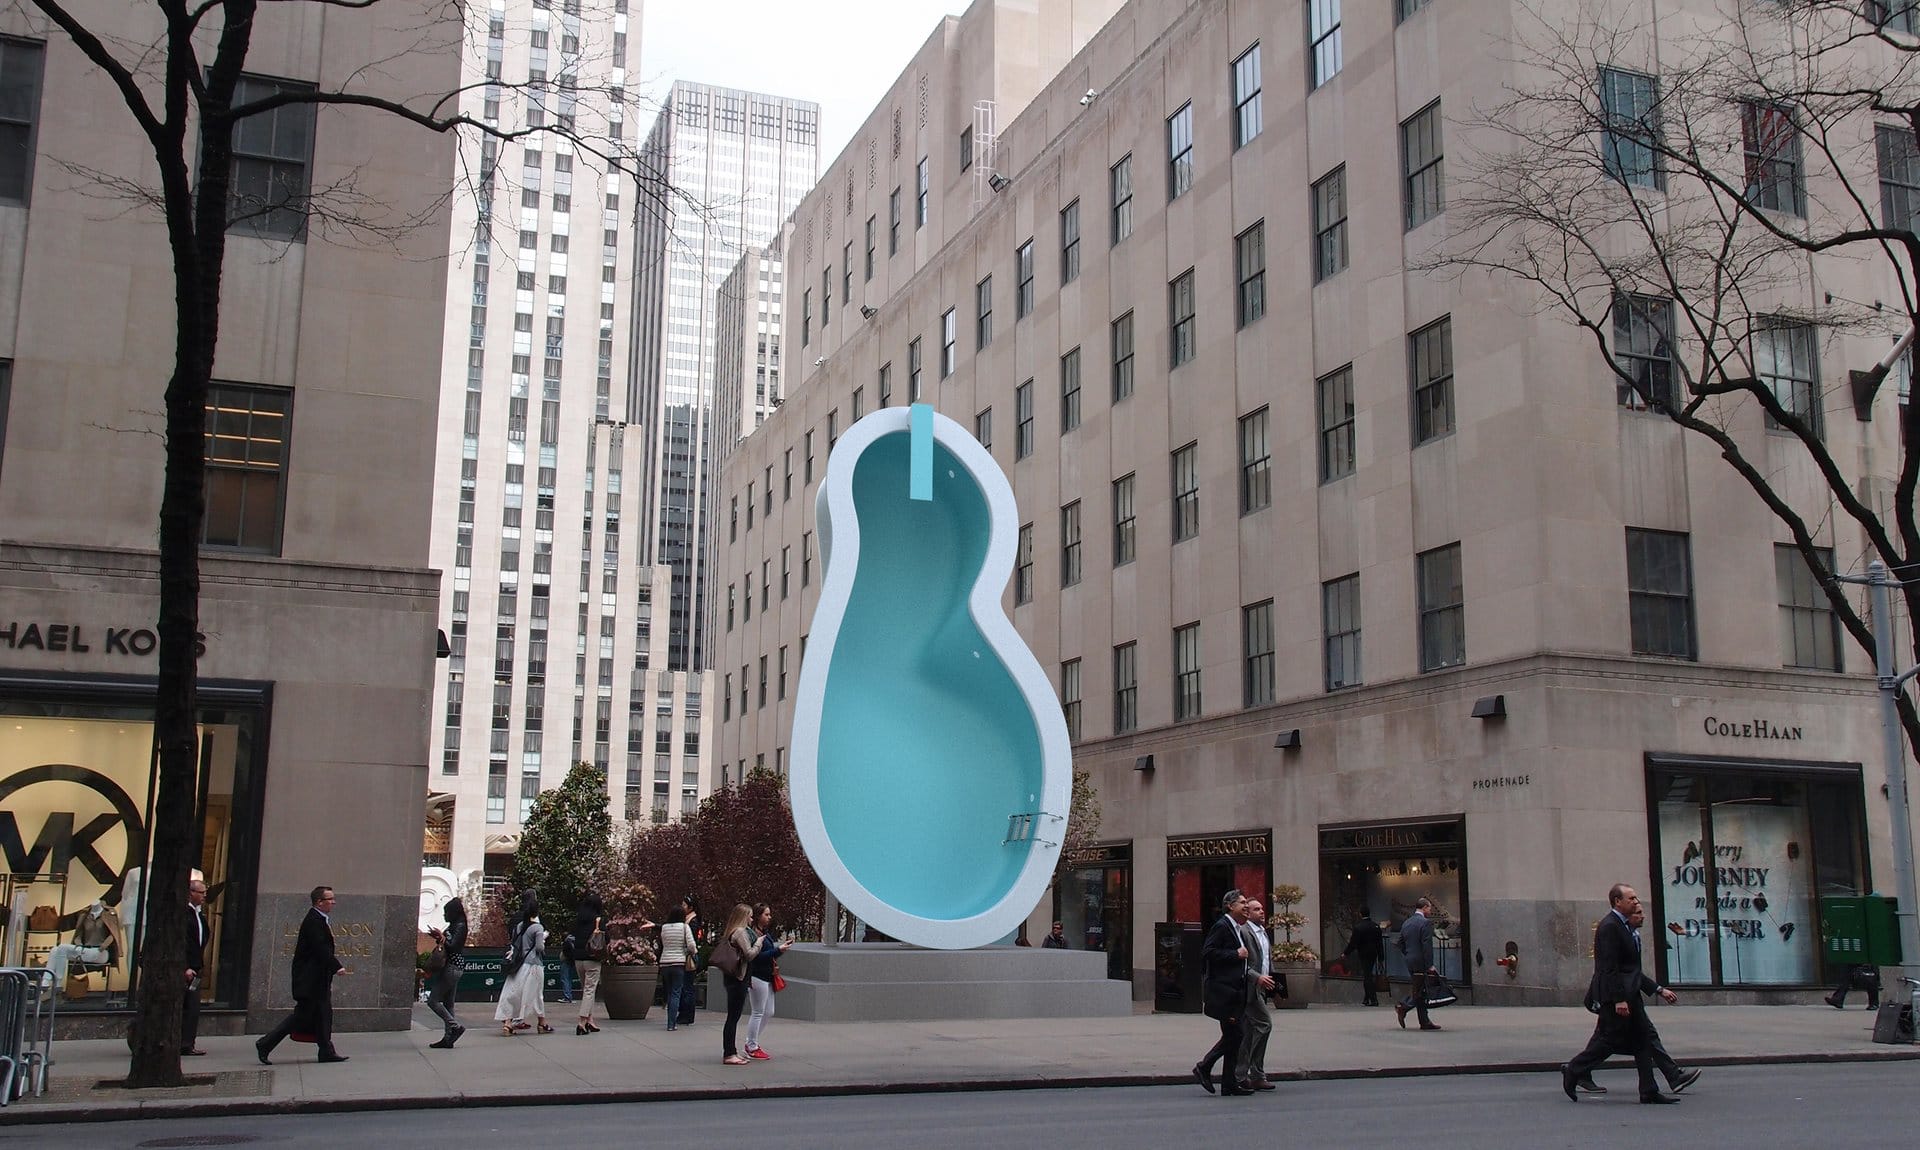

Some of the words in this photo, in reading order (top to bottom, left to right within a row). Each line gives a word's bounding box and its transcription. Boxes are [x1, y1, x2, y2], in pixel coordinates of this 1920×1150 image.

[105, 627, 206, 659] KOS
[1472, 775, 1530, 789] PROMENADE
[1167, 841, 1206, 857] TEUSCHER
[1695, 891, 1737, 909] nds
[1685, 919, 1765, 939] DVER
[486, 962, 501, 970] Cen
